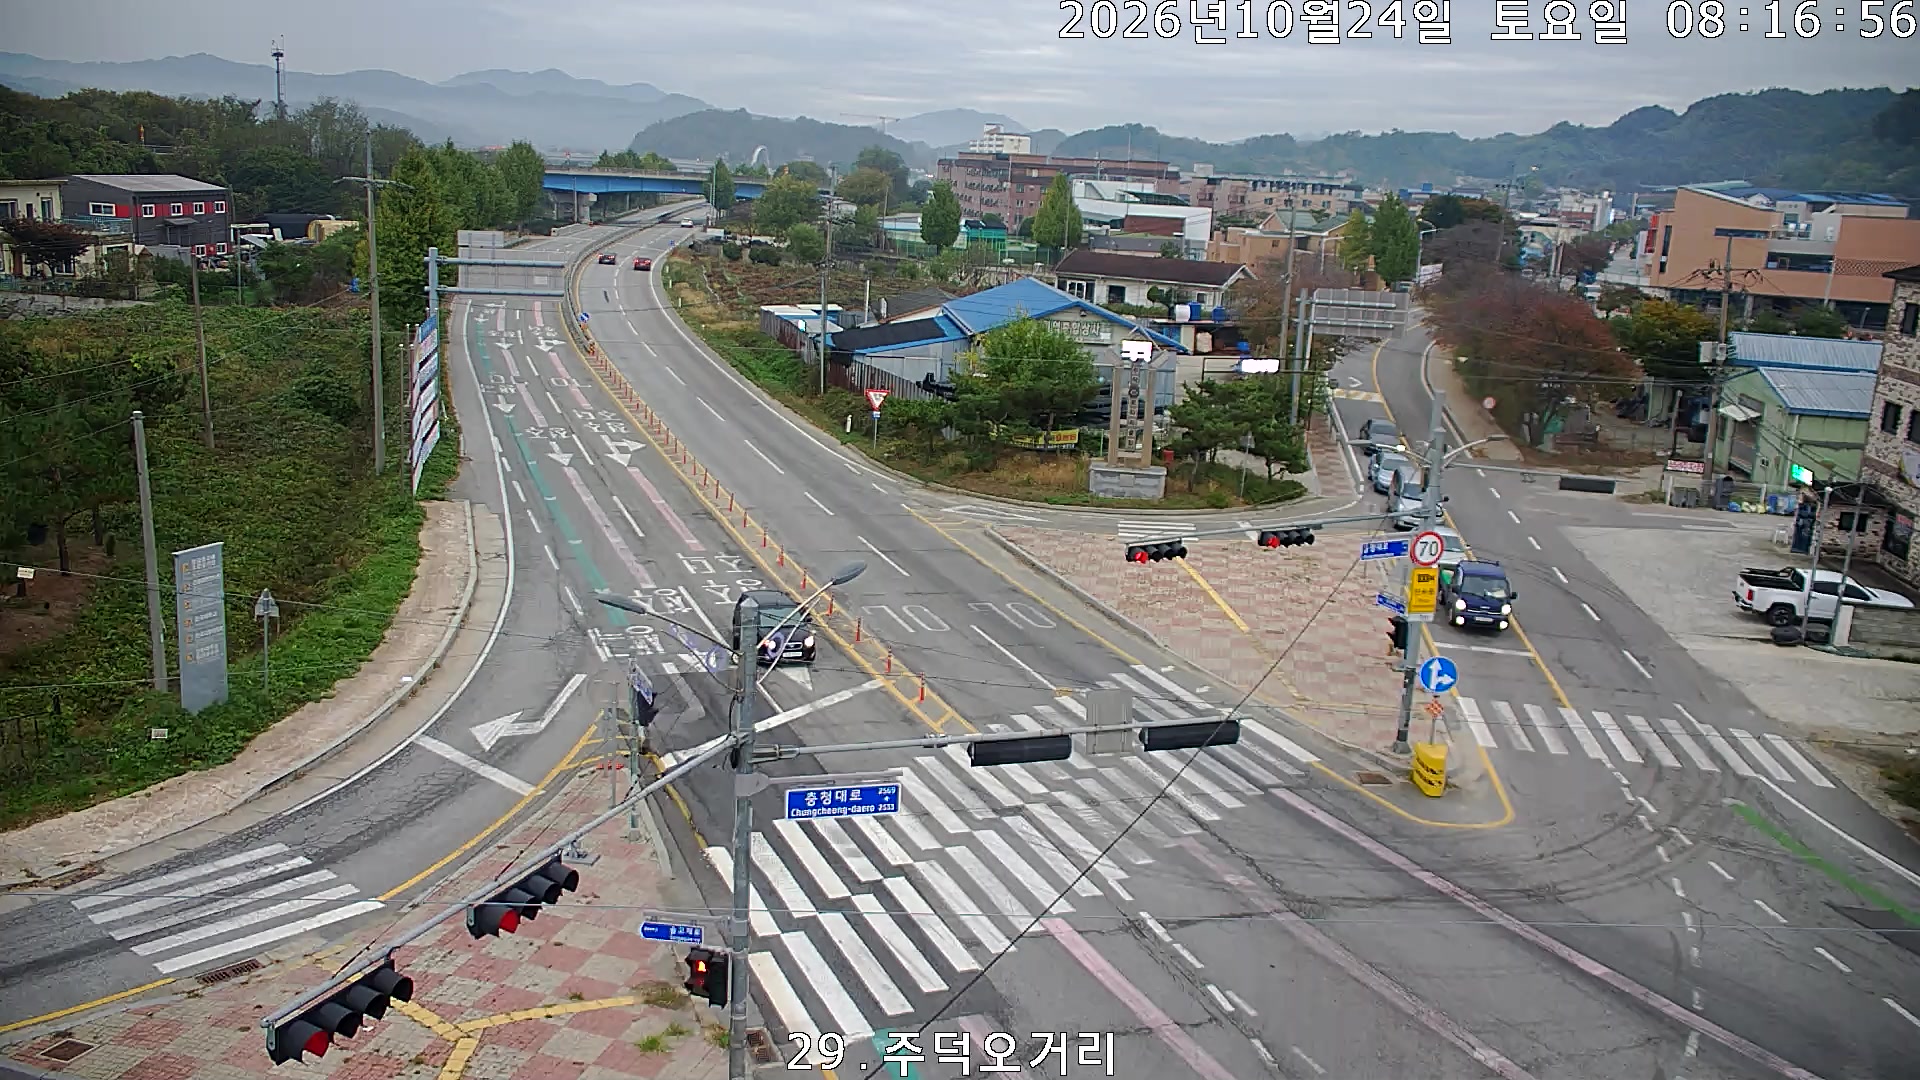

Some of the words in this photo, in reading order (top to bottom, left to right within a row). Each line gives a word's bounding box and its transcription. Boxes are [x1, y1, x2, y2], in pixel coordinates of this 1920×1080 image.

[1420, 541, 1438, 557] 70
[676, 552, 752, 574] 주덕
[861, 605, 951, 632] 70
[967, 602, 1057, 629] 70
[804, 789, 863, 807] 충청대로
[791, 804, 875, 818] Chungcheong-daero
